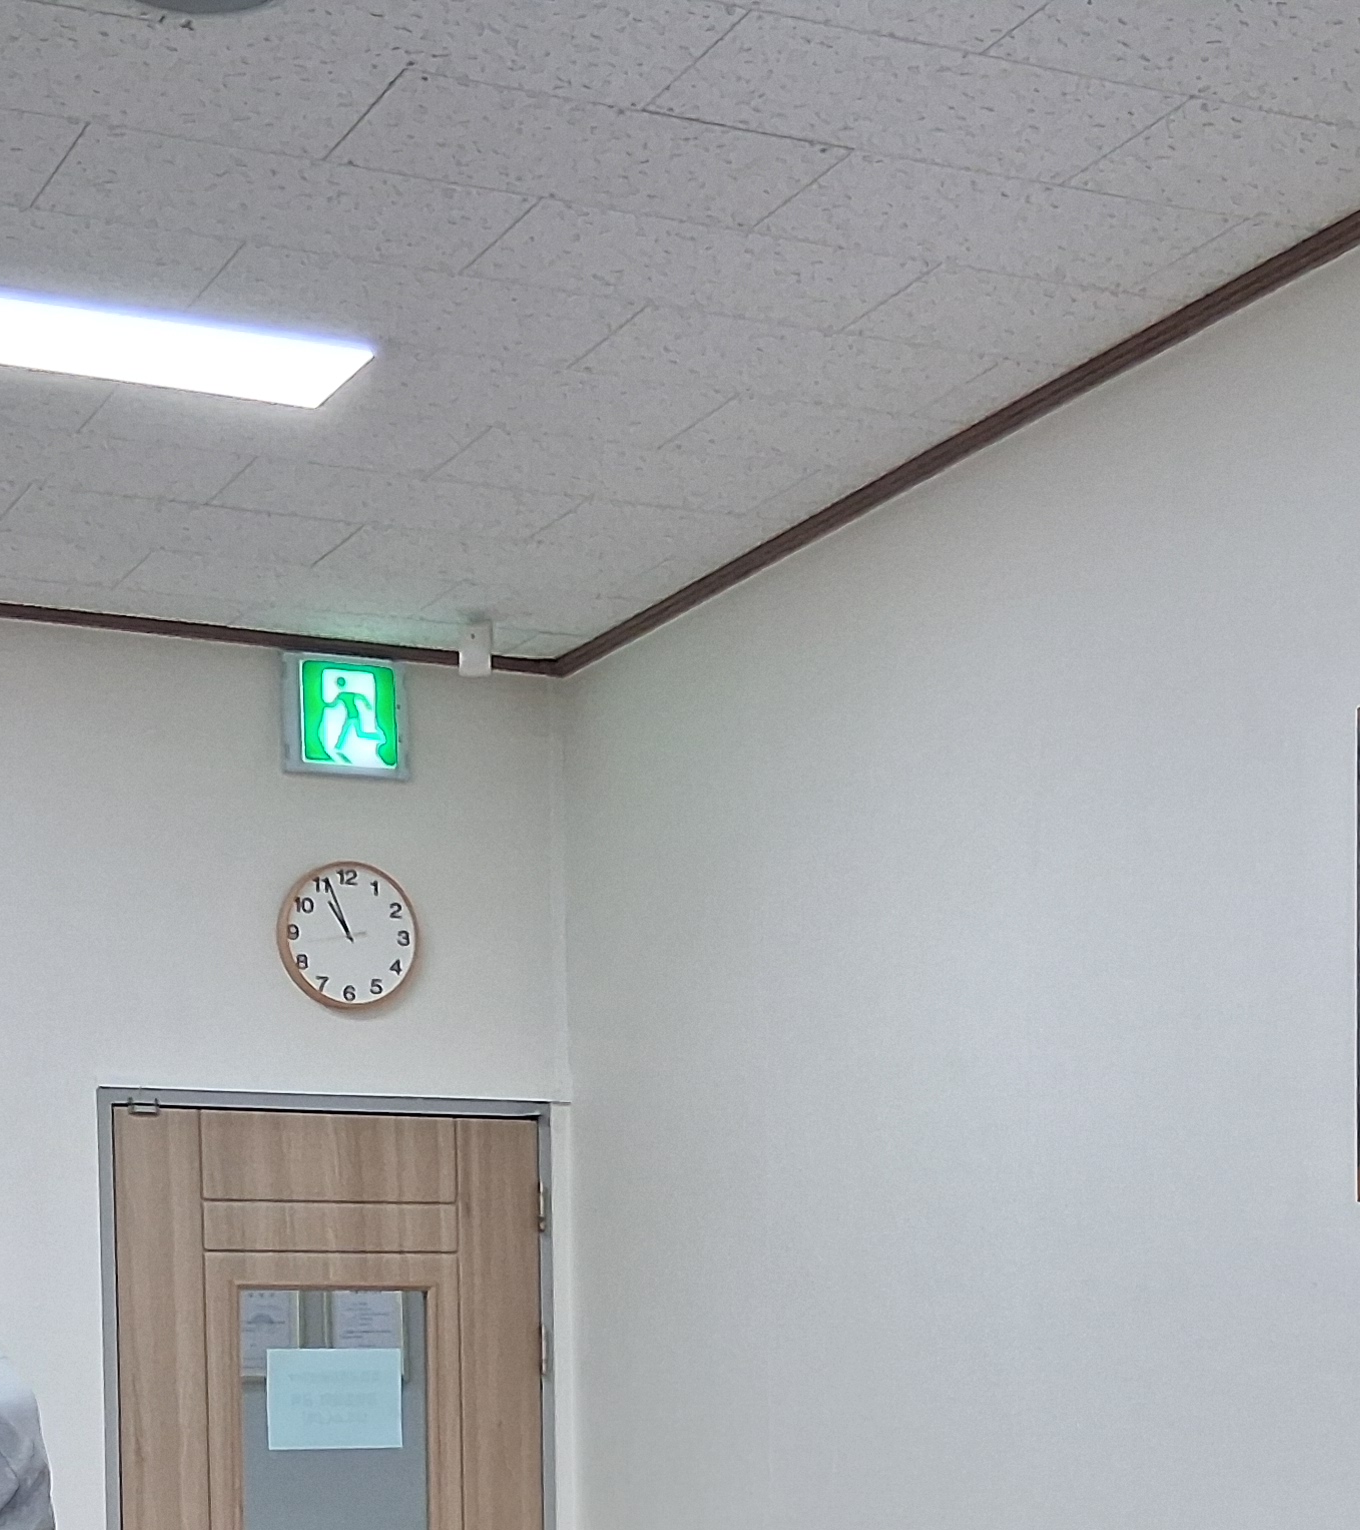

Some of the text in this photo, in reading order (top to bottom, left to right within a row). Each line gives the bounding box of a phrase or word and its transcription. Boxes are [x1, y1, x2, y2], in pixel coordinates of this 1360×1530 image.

[336, 869, 358, 886] 12
[370, 880, 379, 896] 1
[295, 897, 314, 914] 10
[389, 902, 402, 919] 2
[287, 924, 300, 940] 9
[397, 930, 410, 946] 3
[296, 954, 308, 969] 8
[389, 959, 402, 975] 4
[315, 976, 329, 992] 7
[370, 979, 383, 995] 5
[343, 985, 356, 1001] 6
